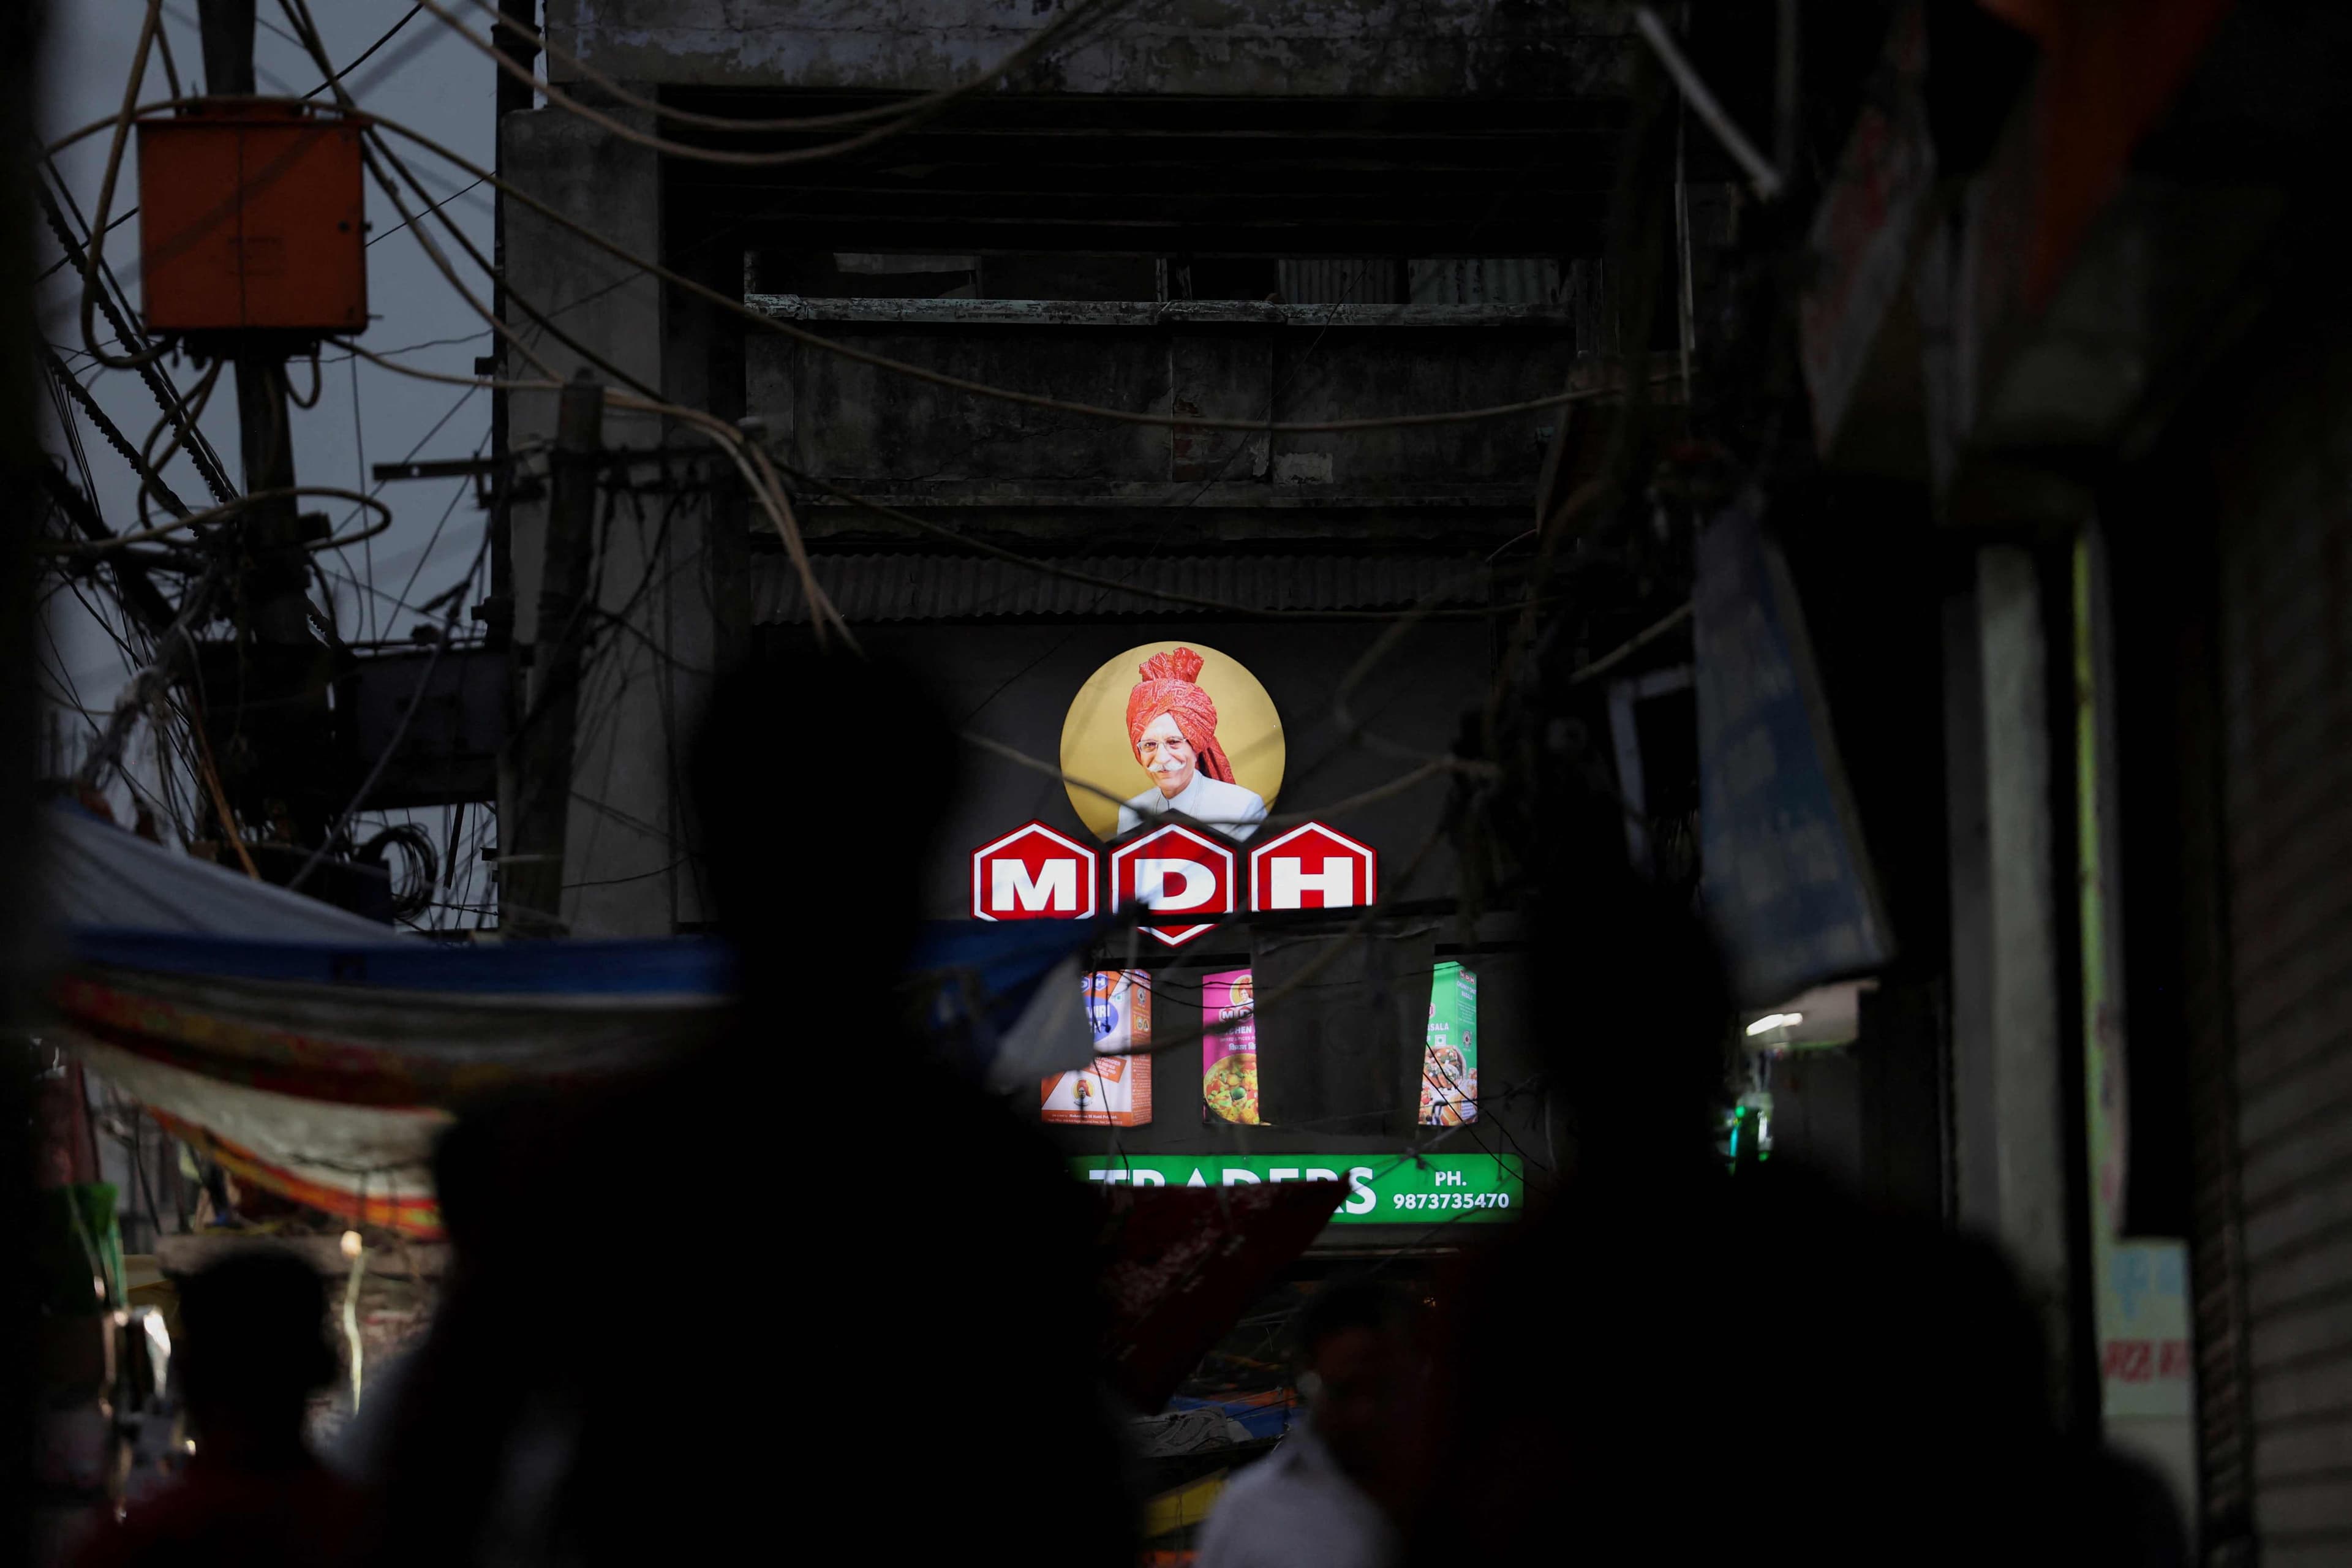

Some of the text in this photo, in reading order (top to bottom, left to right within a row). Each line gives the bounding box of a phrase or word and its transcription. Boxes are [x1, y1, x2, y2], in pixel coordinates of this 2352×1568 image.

[992, 857, 1352, 911] MDH
[1435, 1171, 1467, 1186] PH.
[1393, 1193, 1509, 1210] 9873735470
